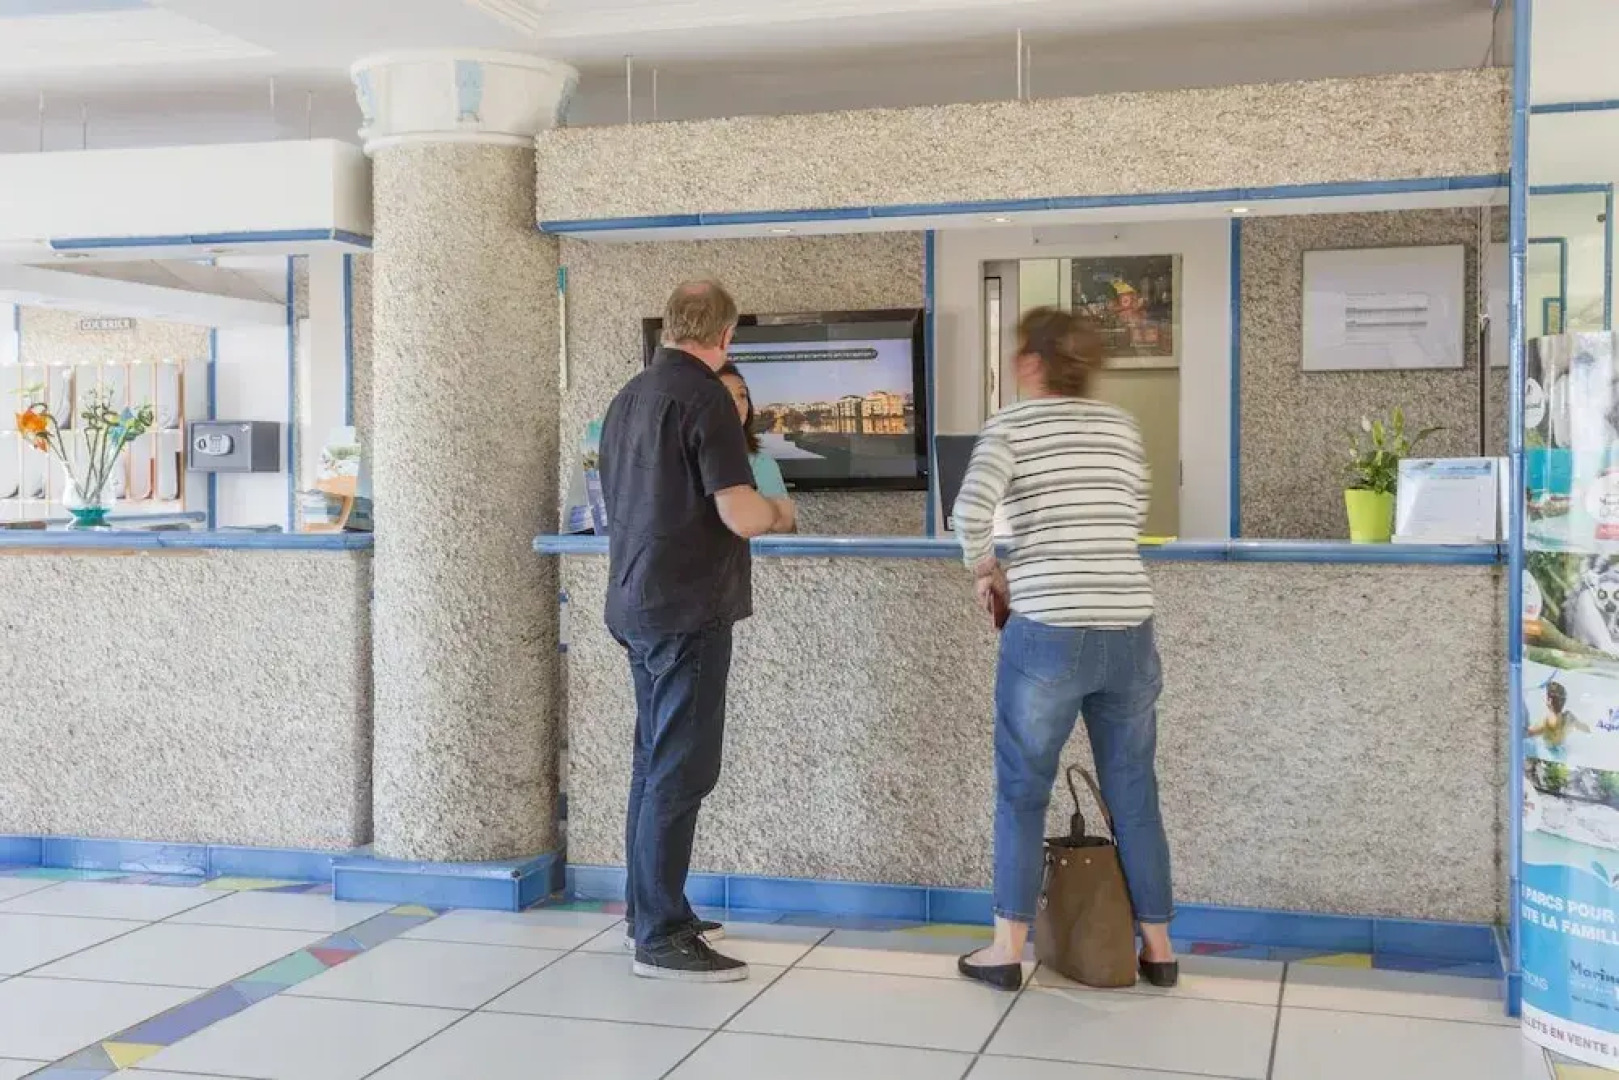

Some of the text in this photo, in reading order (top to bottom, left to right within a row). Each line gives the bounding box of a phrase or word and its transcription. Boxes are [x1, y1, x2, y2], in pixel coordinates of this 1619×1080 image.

[1526, 886, 1615, 924] PARCS POUR
[1541, 911, 1559, 932] LA
[1550, 1026, 1565, 1042] EN
[1567, 1031, 1610, 1055] VENTE
